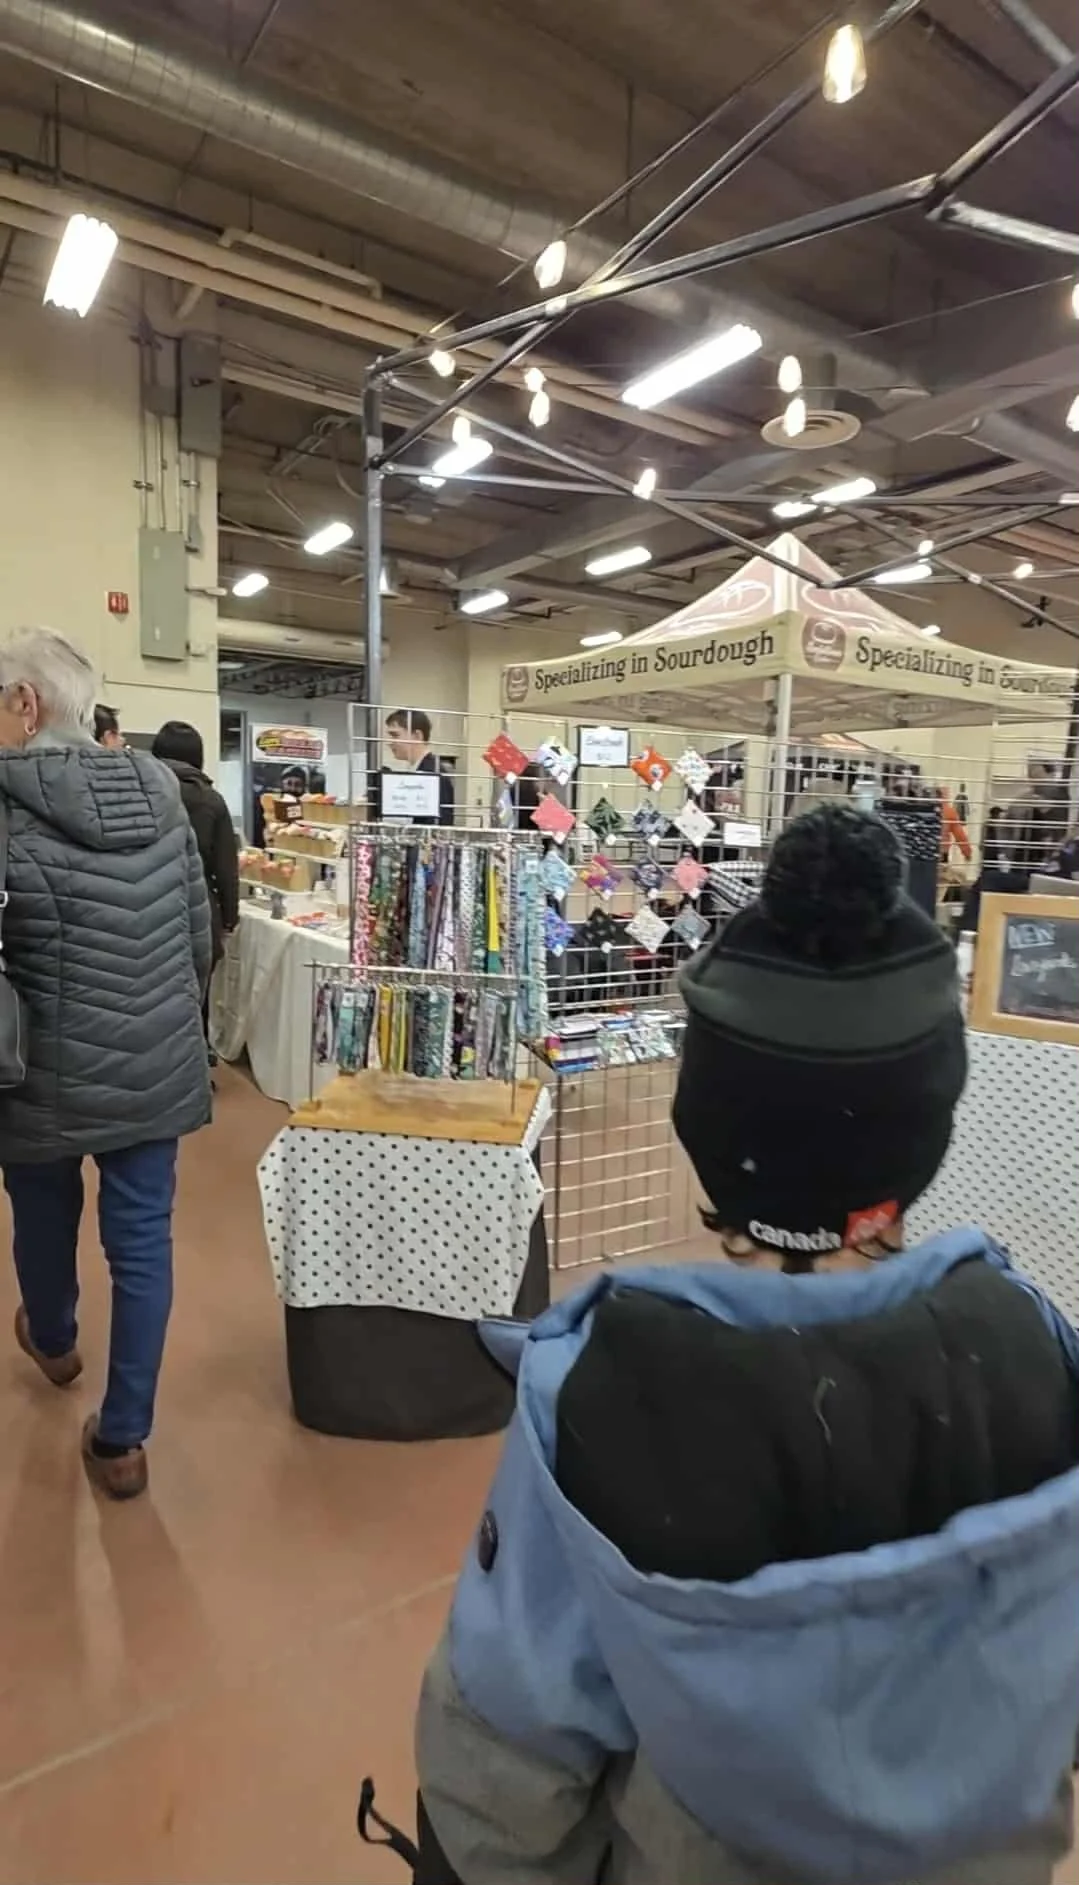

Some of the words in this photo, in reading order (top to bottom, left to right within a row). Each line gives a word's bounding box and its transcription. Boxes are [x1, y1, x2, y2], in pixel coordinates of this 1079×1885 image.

[535, 658, 626, 693] Specializing
[631, 652, 648, 674] in
[654, 630, 774, 672] Sourdough
[856, 635, 973, 687] Specializing
[978, 660, 996, 686] in
[748, 1219, 842, 1251] canada
